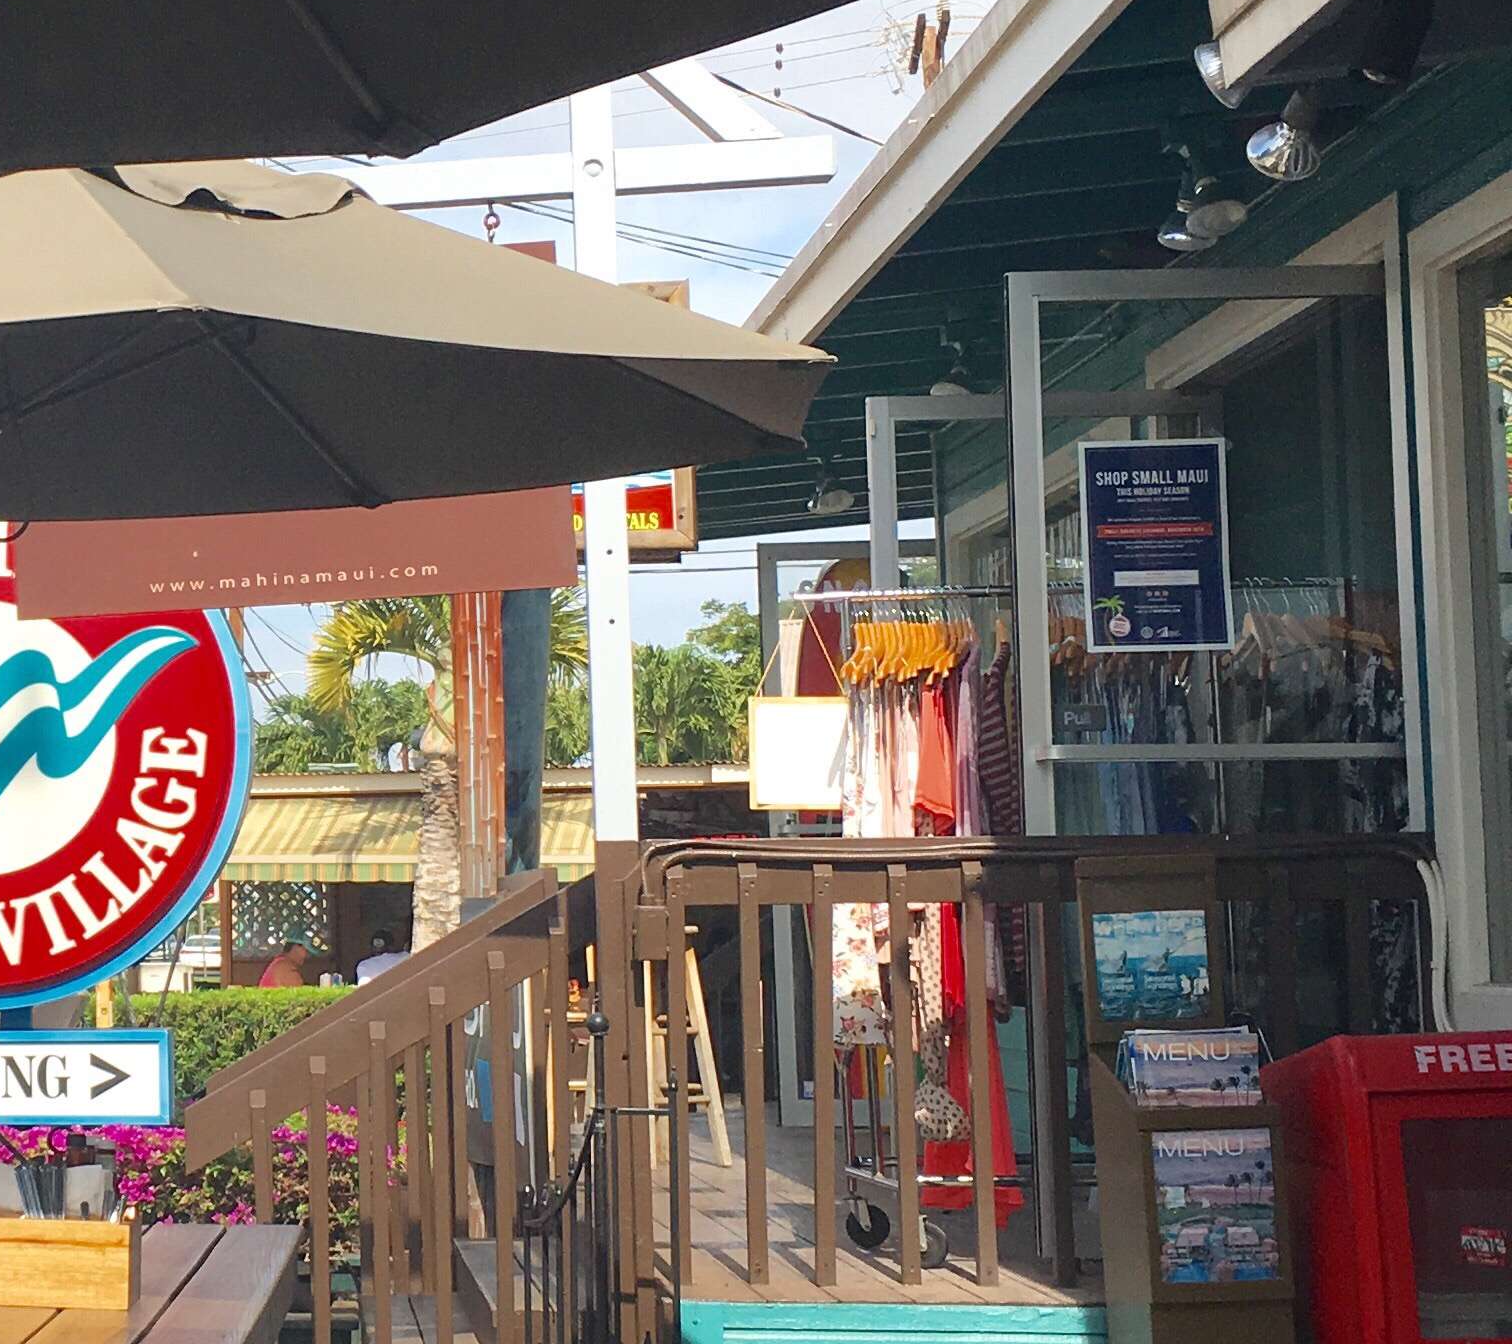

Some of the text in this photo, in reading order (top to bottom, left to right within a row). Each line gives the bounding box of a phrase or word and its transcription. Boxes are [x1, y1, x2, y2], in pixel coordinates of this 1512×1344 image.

[1096, 469, 1209, 486] SHOP SMALL MAUI
[1133, 487, 1162, 496] HOLIDAY
[1163, 486, 1190, 495] SEASON
[149, 564, 438, 594] www.mahinamaui.com
[1143, 1041, 1230, 1062] MENU
[1413, 1043, 1512, 1073] FREE
[1157, 1138, 1244, 1158] MENU
